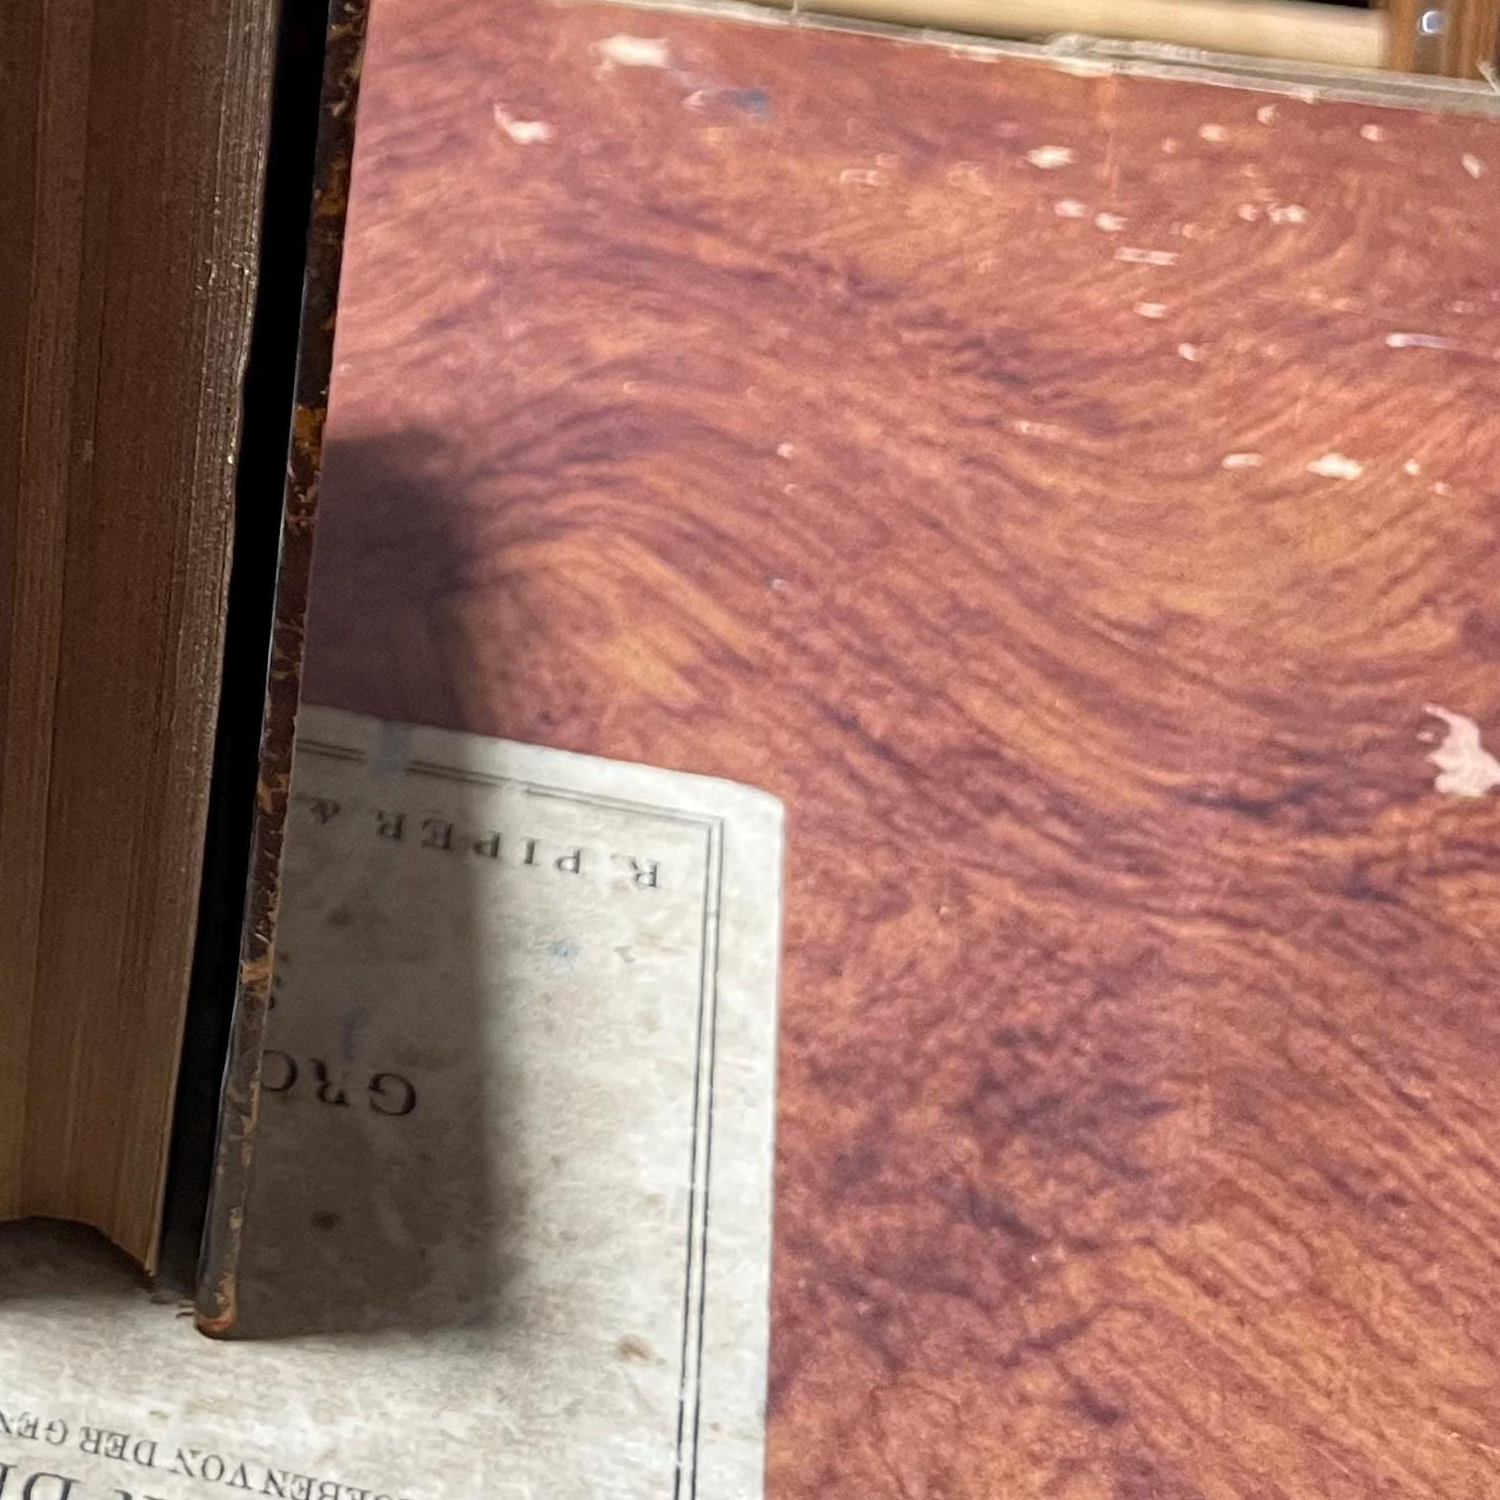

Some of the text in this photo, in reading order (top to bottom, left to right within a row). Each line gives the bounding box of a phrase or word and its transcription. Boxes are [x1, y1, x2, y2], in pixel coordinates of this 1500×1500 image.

[307, 799, 342, 826] &
[374, 809, 583, 875] PIPER
[79, 1426, 158, 1468] DER
[166, 1449, 252, 1490] VON
